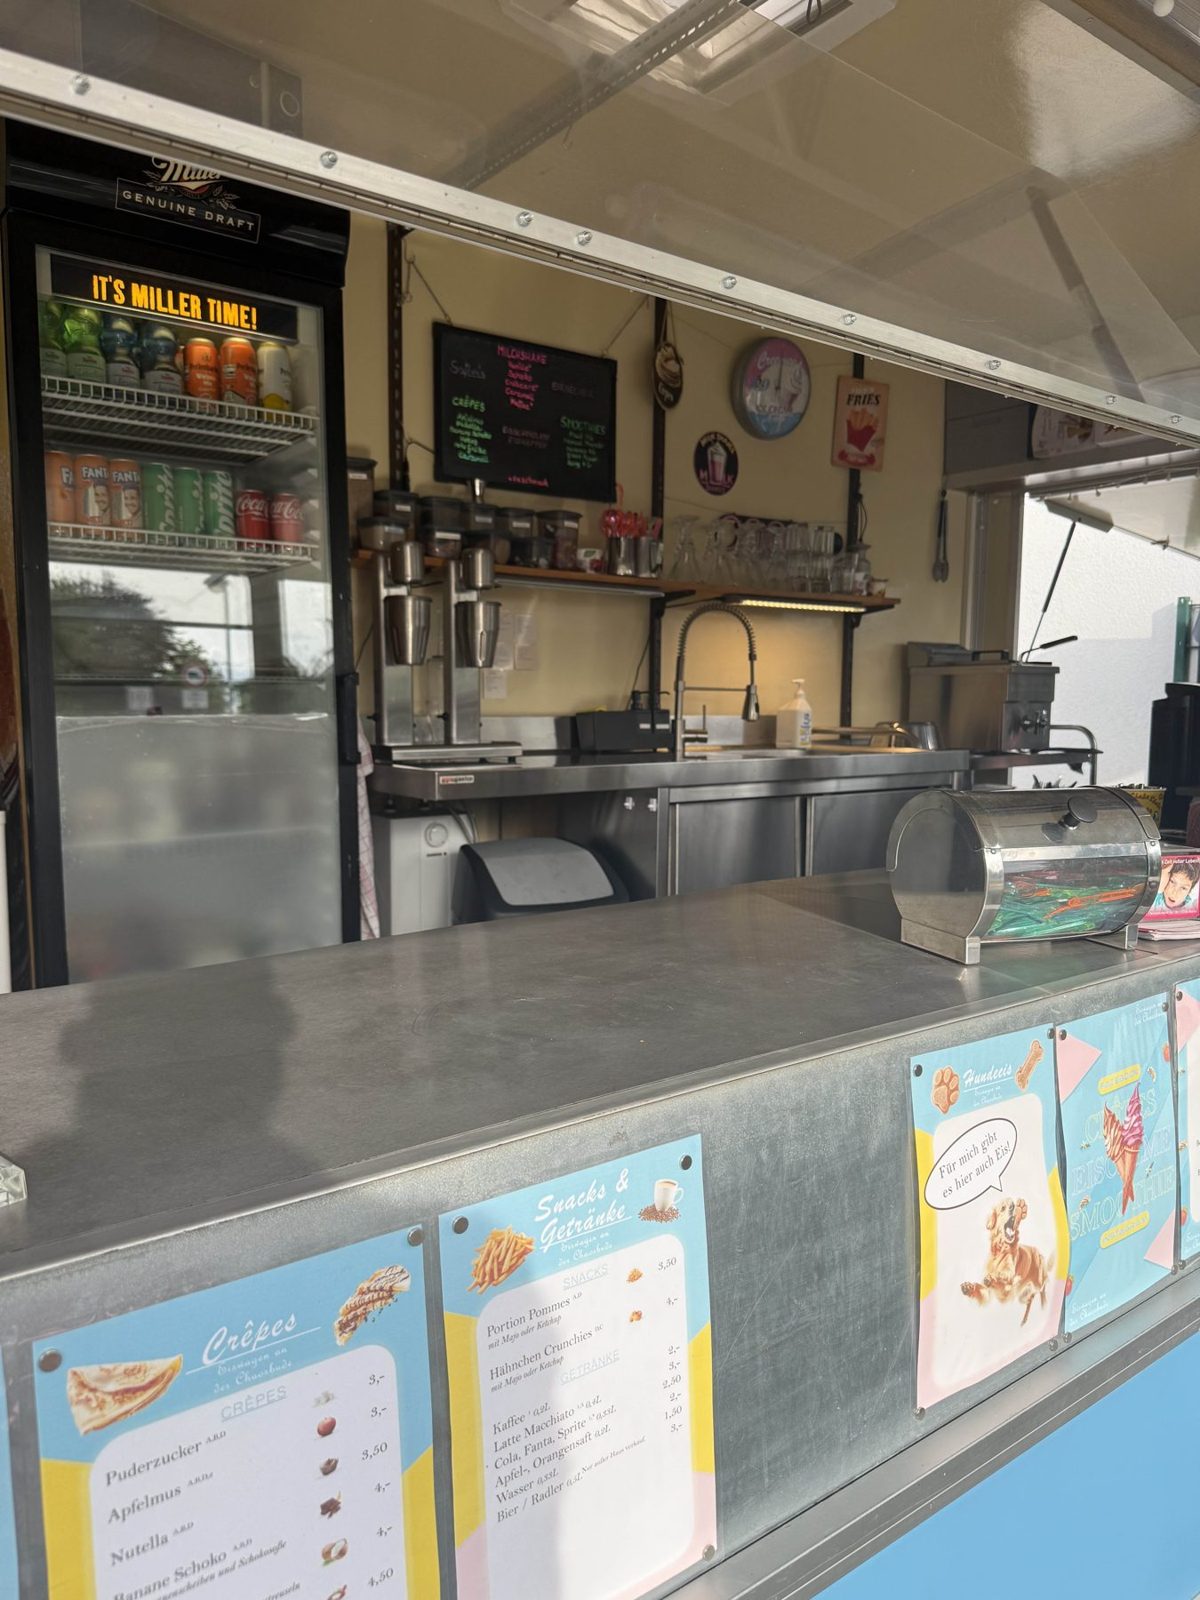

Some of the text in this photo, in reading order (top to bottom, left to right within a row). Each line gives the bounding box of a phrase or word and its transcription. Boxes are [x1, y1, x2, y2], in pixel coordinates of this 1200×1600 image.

[122, 190, 255, 231] GENUINE DRAFT
[92, 274, 258, 331] IT'S MILLER TIME!
[846, 392, 881, 406] FRIES
[81, 466, 109, 480] FANT
[939, 1132, 998, 1179] Für mich gibt
[942, 1140, 1011, 1198] es hier auch Eis!
[534, 1168, 629, 1222] Snacks &
[540, 1199, 625, 1253] Getränke
[563, 1263, 609, 1290] SNACKS
[658, 1257, 677, 1271] 3,50
[487, 1315, 526, 1337] Portion
[529, 1298, 570, 1320] Pommes
[487, 1315, 562, 1350] mit Mayo oder Ketchup
[202, 1313, 297, 1365] Crêpes
[490, 1351, 541, 1380] Hähnchen
[544, 1329, 593, 1355] Crunchies
[668, 1344, 681, 1355] 2,-
[368, 1374, 385, 1386] 3,-
[490, 1355, 564, 1393] mit Mayo oder Ketchup
[662, 1375, 682, 1389] 2,50
[668, 1361, 681, 1371] 3,-
[221, 1385, 288, 1420] CRÊPES
[371, 1407, 387, 1418] 3,-
[664, 1405, 683, 1420] 1,50
[669, 1392, 682, 1402] 2,-
[493, 1414, 526, 1435] Kaffee
[494, 1435, 521, 1453] Latte
[524, 1409, 574, 1439] Macchiato
[671, 1423, 683, 1433] 3,-
[362, 1441, 389, 1461] 3,50
[494, 1453, 521, 1470] Cola,
[524, 1438, 556, 1457] Fanta,
[557, 1419, 586, 1440] Sprite
[532, 1431, 592, 1469] Orangensaft
[105, 1441, 203, 1487] Puderzucker
[107, 1485, 182, 1524] Apfelmus
[496, 1479, 534, 1504] Wasser
[497, 1504, 519, 1523] Bier
[522, 1499, 528, 1512] /
[531, 1482, 564, 1507] Radler
[110, 1533, 170, 1567] Nutella
[173, 1551, 228, 1582] Schoko
[218, 1562, 236, 1578] und
[237, 1539, 287, 1569] Schokosoße
[367, 1567, 394, 1587] 4,50
